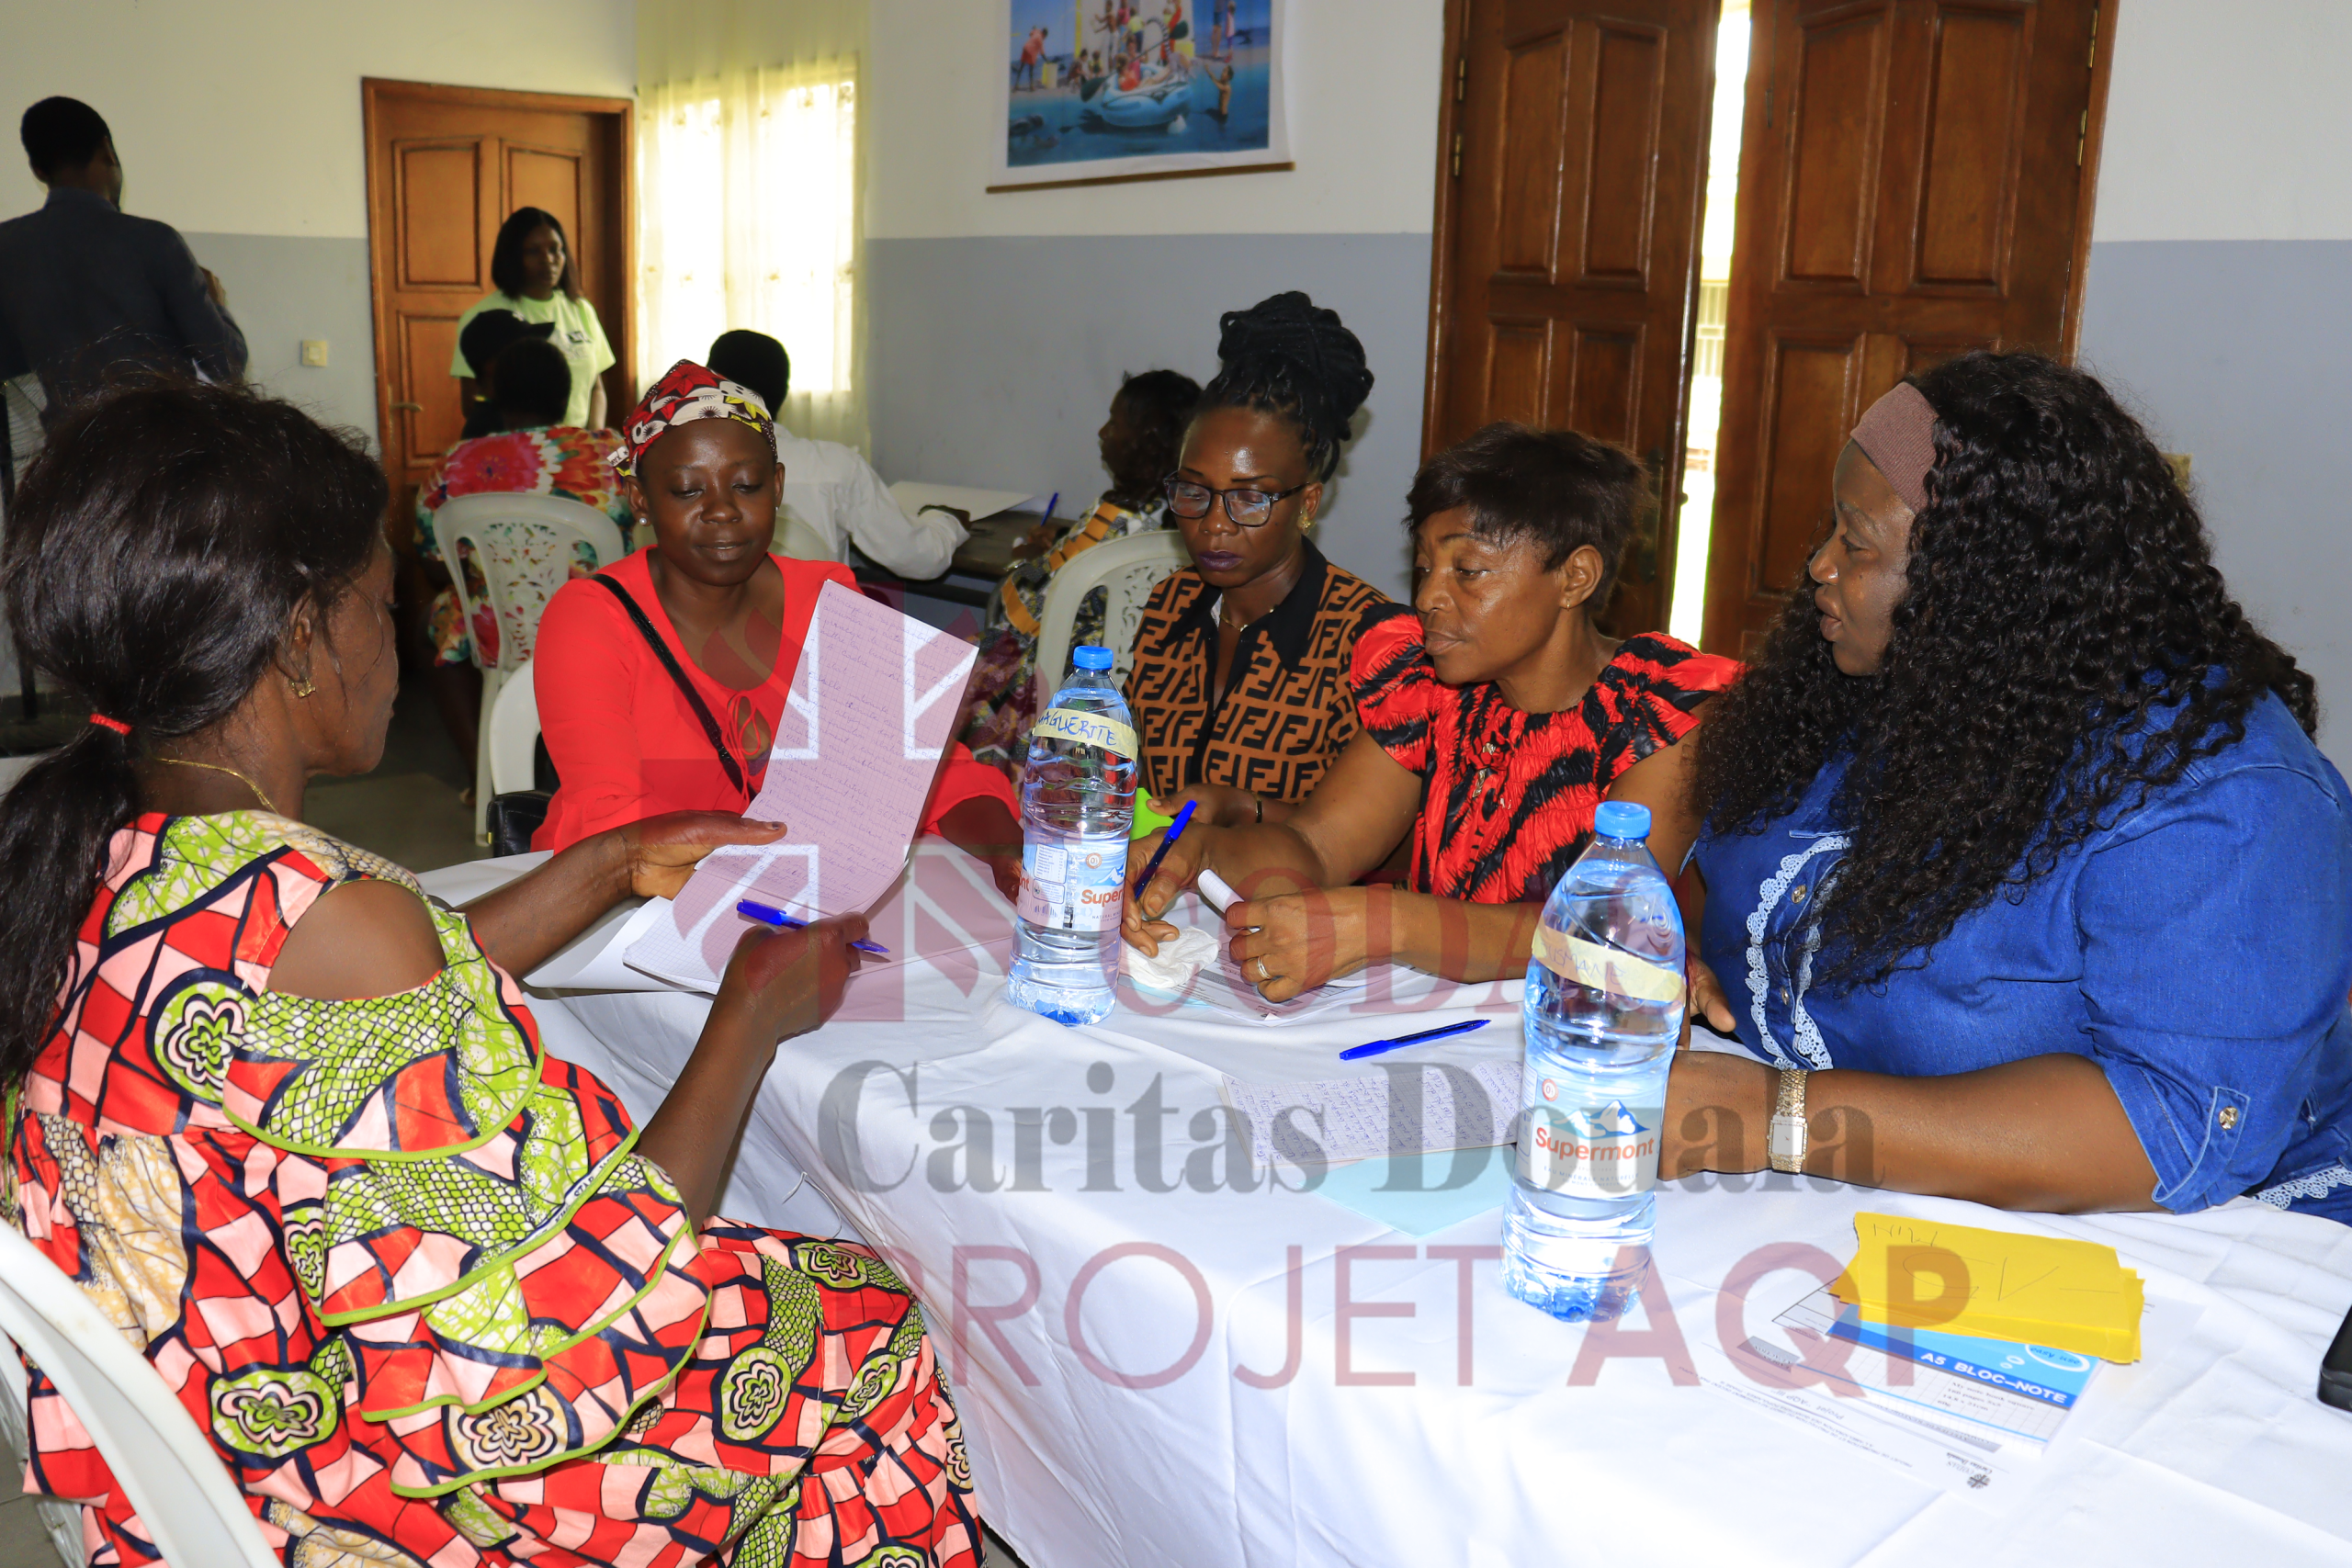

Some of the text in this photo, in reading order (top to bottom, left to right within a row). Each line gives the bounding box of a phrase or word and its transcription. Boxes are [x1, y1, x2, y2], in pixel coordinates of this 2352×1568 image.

[1080, 887, 1124, 907] Super
[1535, 1126, 1655, 1161] Supermont
[1544, 1165, 1556, 1175] EAU
[2030, 1347, 2082, 1366] easy use
[1920, 1352, 2068, 1404] A5 BLOC-NOTE
[1815, 1403, 1844, 1420] Projet
